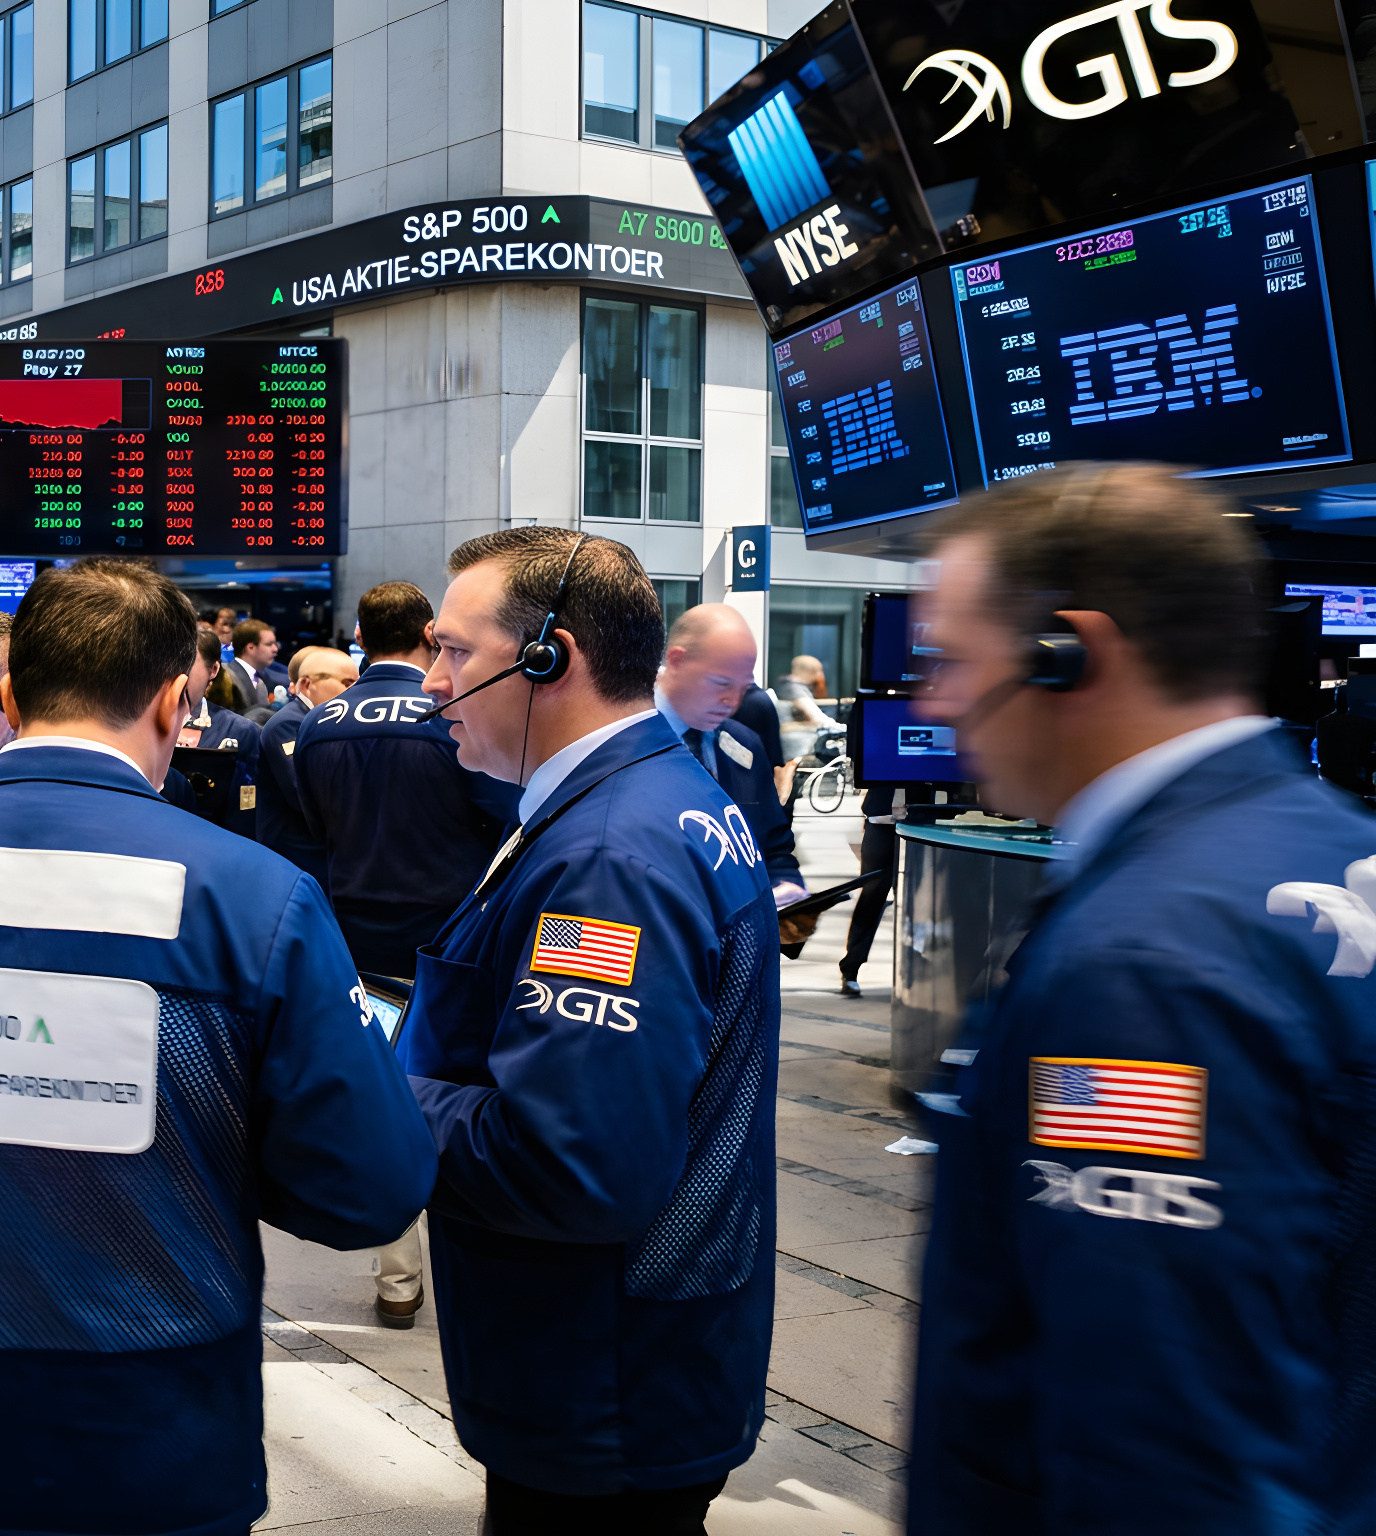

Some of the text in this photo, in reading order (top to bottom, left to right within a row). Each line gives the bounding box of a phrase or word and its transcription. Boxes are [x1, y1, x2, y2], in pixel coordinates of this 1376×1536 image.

[1021, 0, 1238, 120] GTS
[402, 203, 529, 243] S&P 500
[773, 203, 859, 286] NYSE
[292, 241, 665, 307] USA AKTIE-SPAREKONTOER
[1059, 303, 1251, 426] IBM
[353, 696, 433, 724] GTS
[555, 986, 641, 1033] GTS
